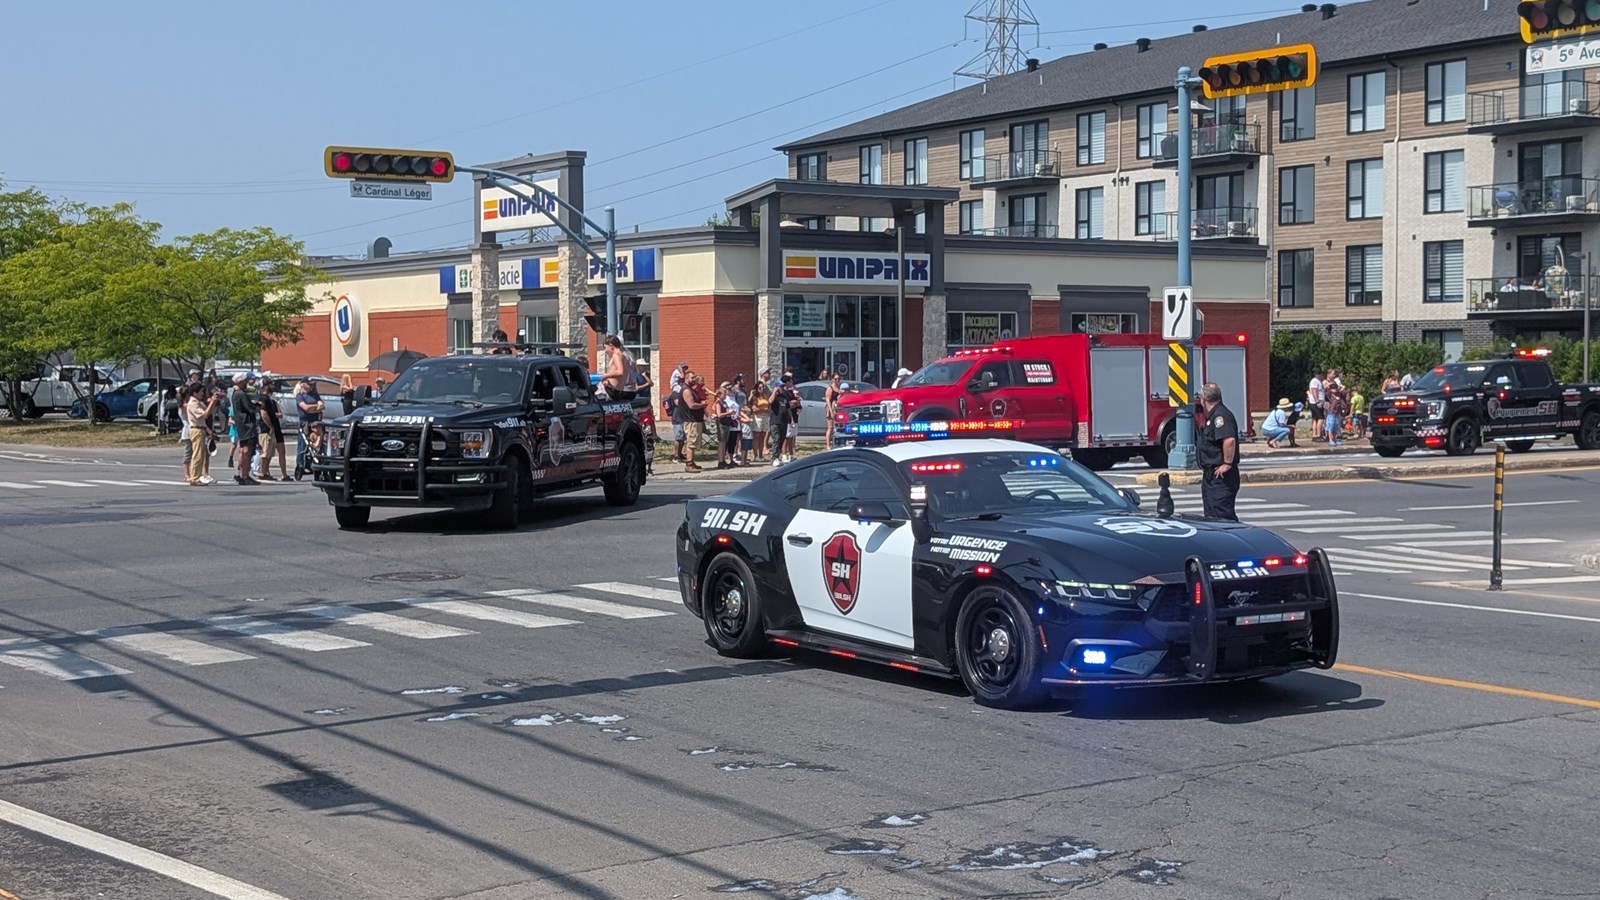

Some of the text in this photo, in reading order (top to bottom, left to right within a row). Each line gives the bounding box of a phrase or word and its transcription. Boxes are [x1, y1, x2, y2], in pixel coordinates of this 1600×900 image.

[365, 186, 430, 199] Cardinal Léger
[819, 257, 929, 281] UNIPRIX
[701, 507, 768, 536] 911.SH
[949, 548, 1001, 563] MISSION
[831, 561, 851, 579] SH
[1210, 566, 1269, 579] 911.SH
